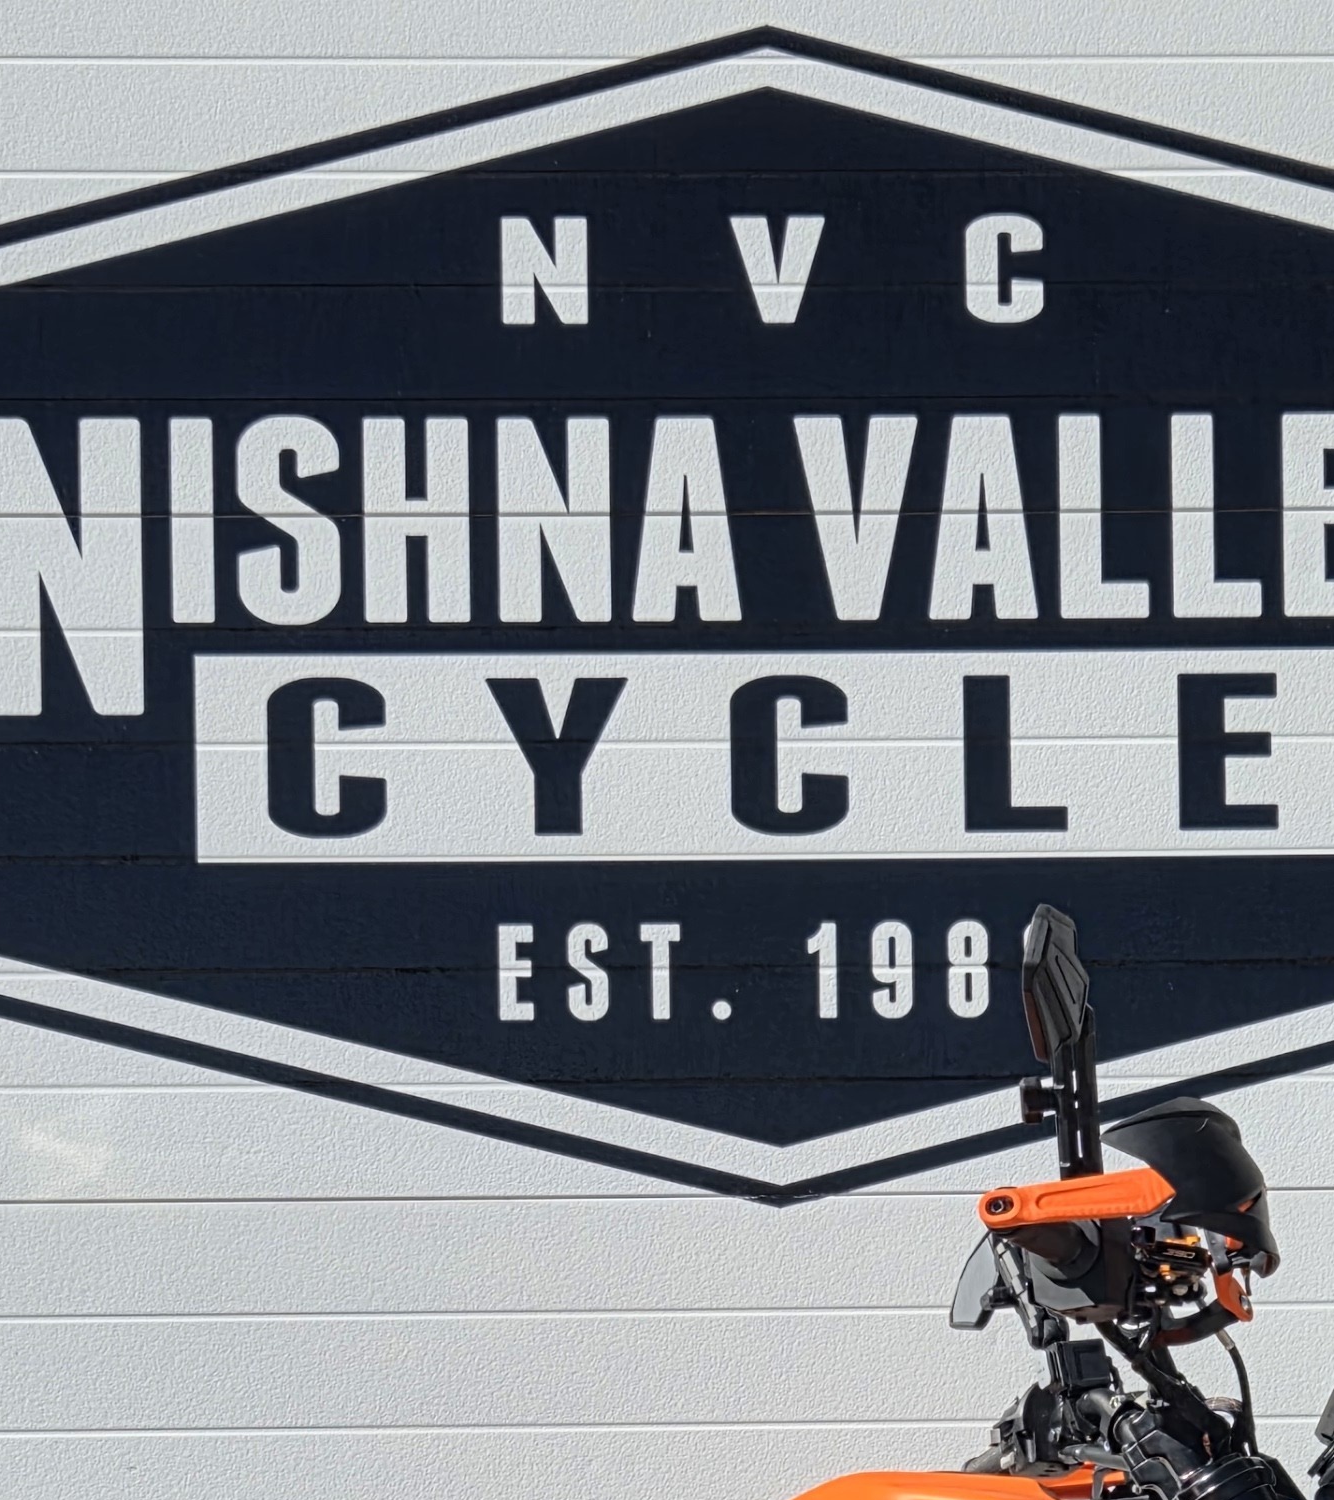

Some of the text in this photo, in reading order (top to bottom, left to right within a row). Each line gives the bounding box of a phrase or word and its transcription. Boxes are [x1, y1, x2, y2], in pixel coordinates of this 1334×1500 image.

[265, 671, 1279, 840] CYCLE
[496, 918, 1027, 1023] EST. 198
